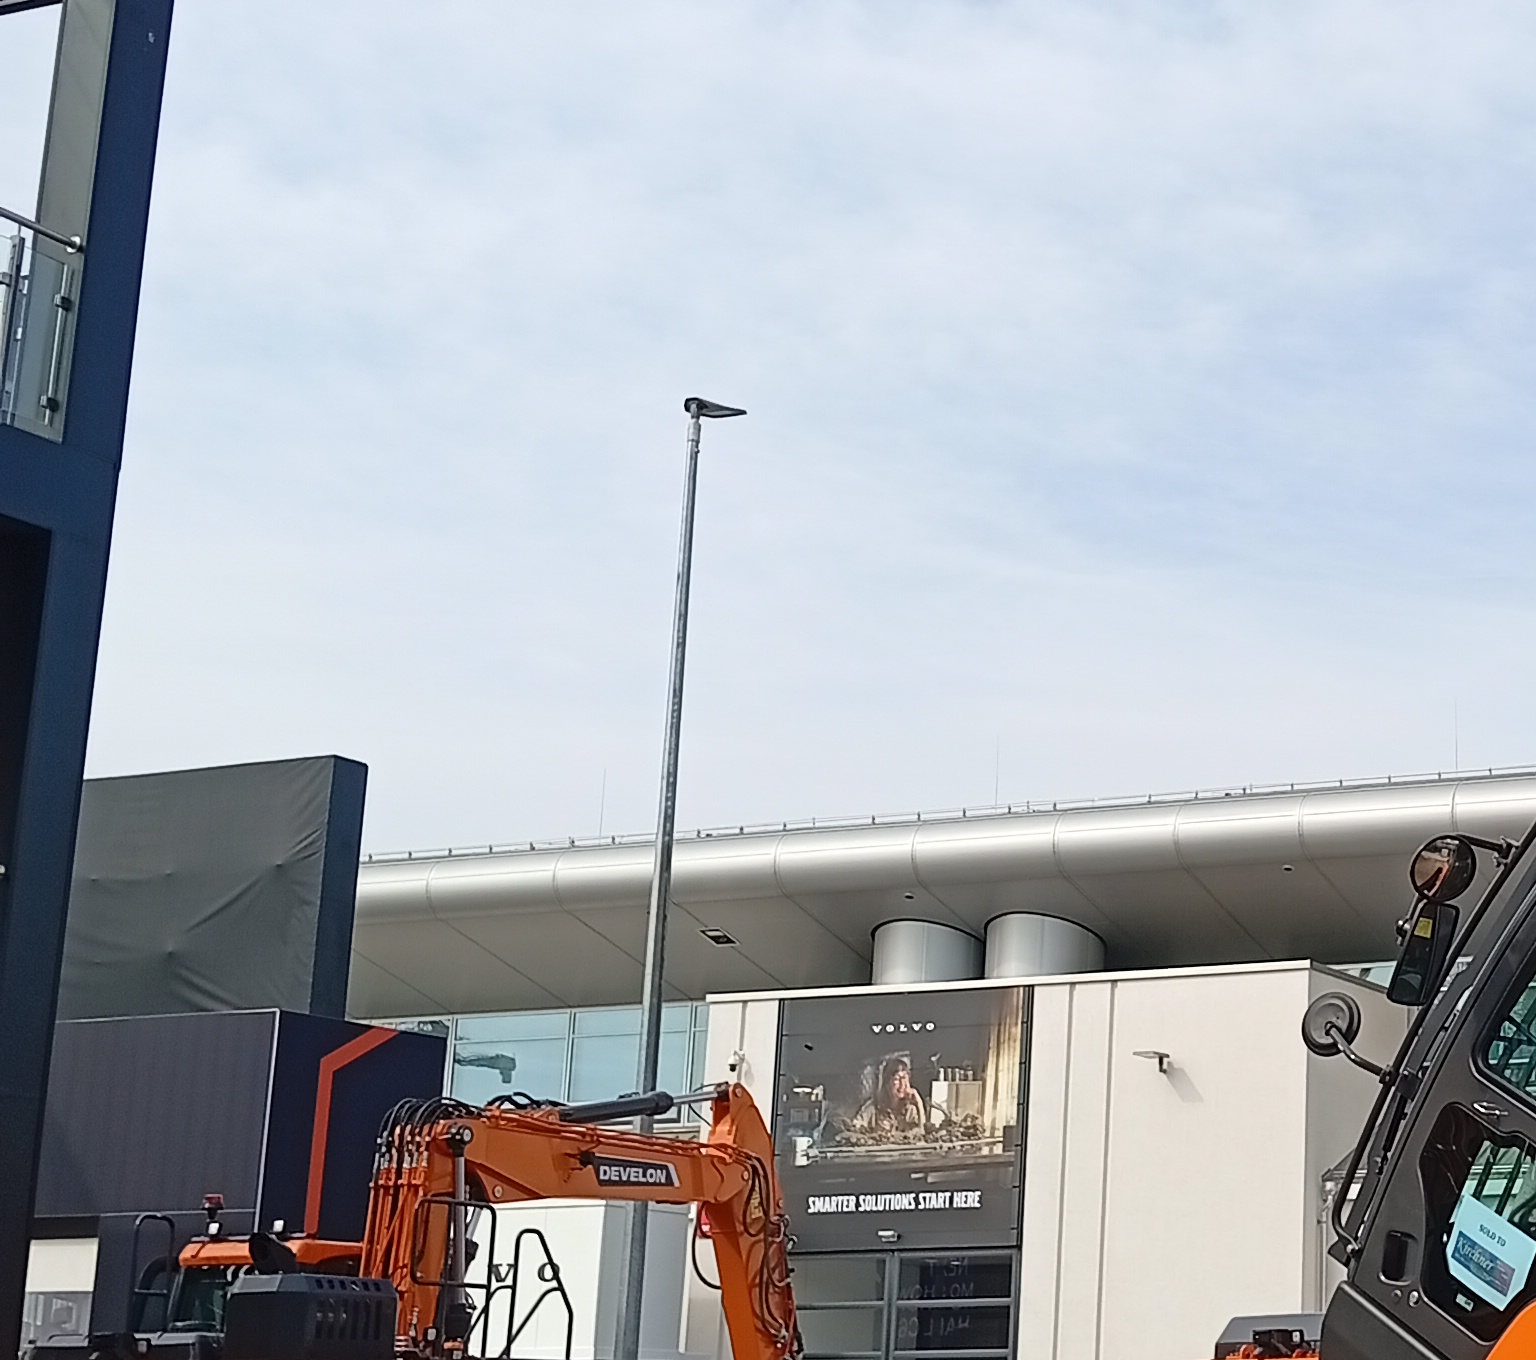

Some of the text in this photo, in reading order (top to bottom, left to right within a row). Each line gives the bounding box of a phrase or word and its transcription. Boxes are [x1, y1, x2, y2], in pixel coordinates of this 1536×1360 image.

[871, 1022, 936, 1034] VOLVO
[599, 1165, 667, 1183] DEVELON
[807, 1190, 982, 1214] SMARTER SOLUTIONS START HERE
[1479, 1223, 1507, 1247] SOLD TO
